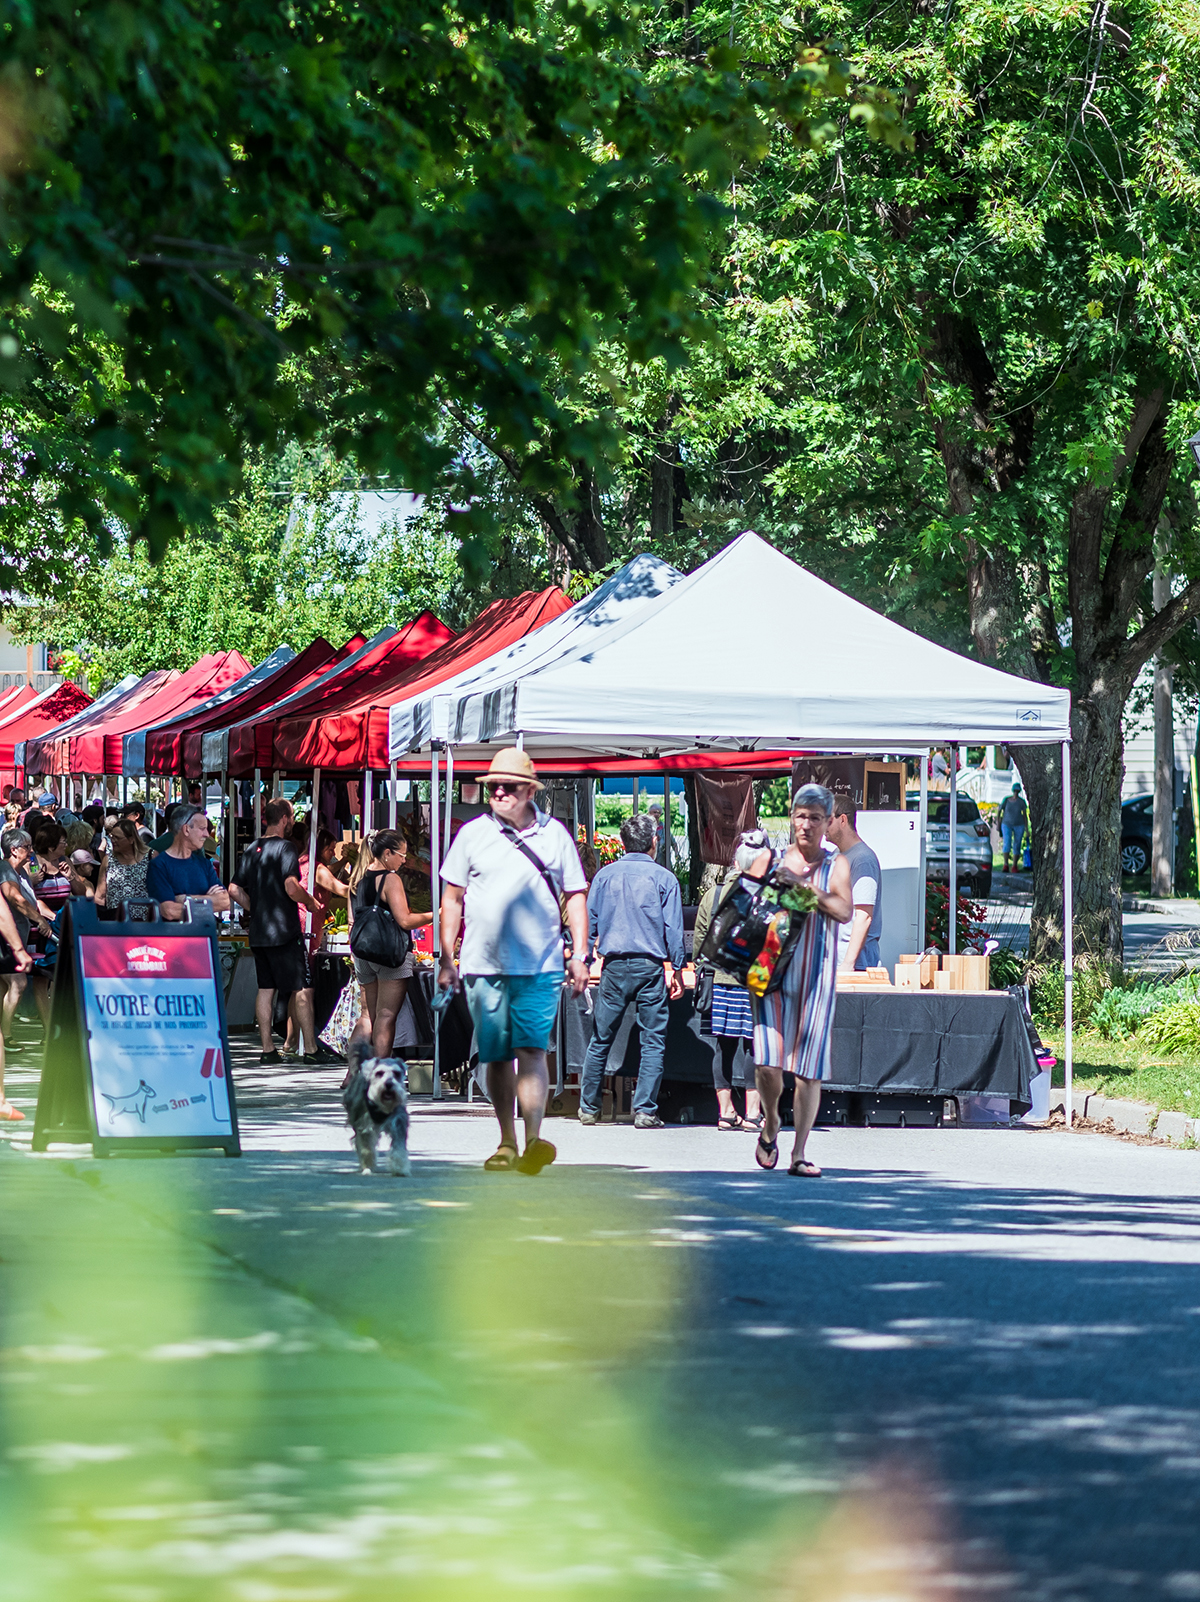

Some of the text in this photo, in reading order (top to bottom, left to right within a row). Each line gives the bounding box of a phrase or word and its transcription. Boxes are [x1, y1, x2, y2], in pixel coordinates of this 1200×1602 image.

[909, 820, 915, 831] 3
[94, 994, 206, 1017] VOTRE CHIEN
[169, 1098, 190, 1110] 3m
